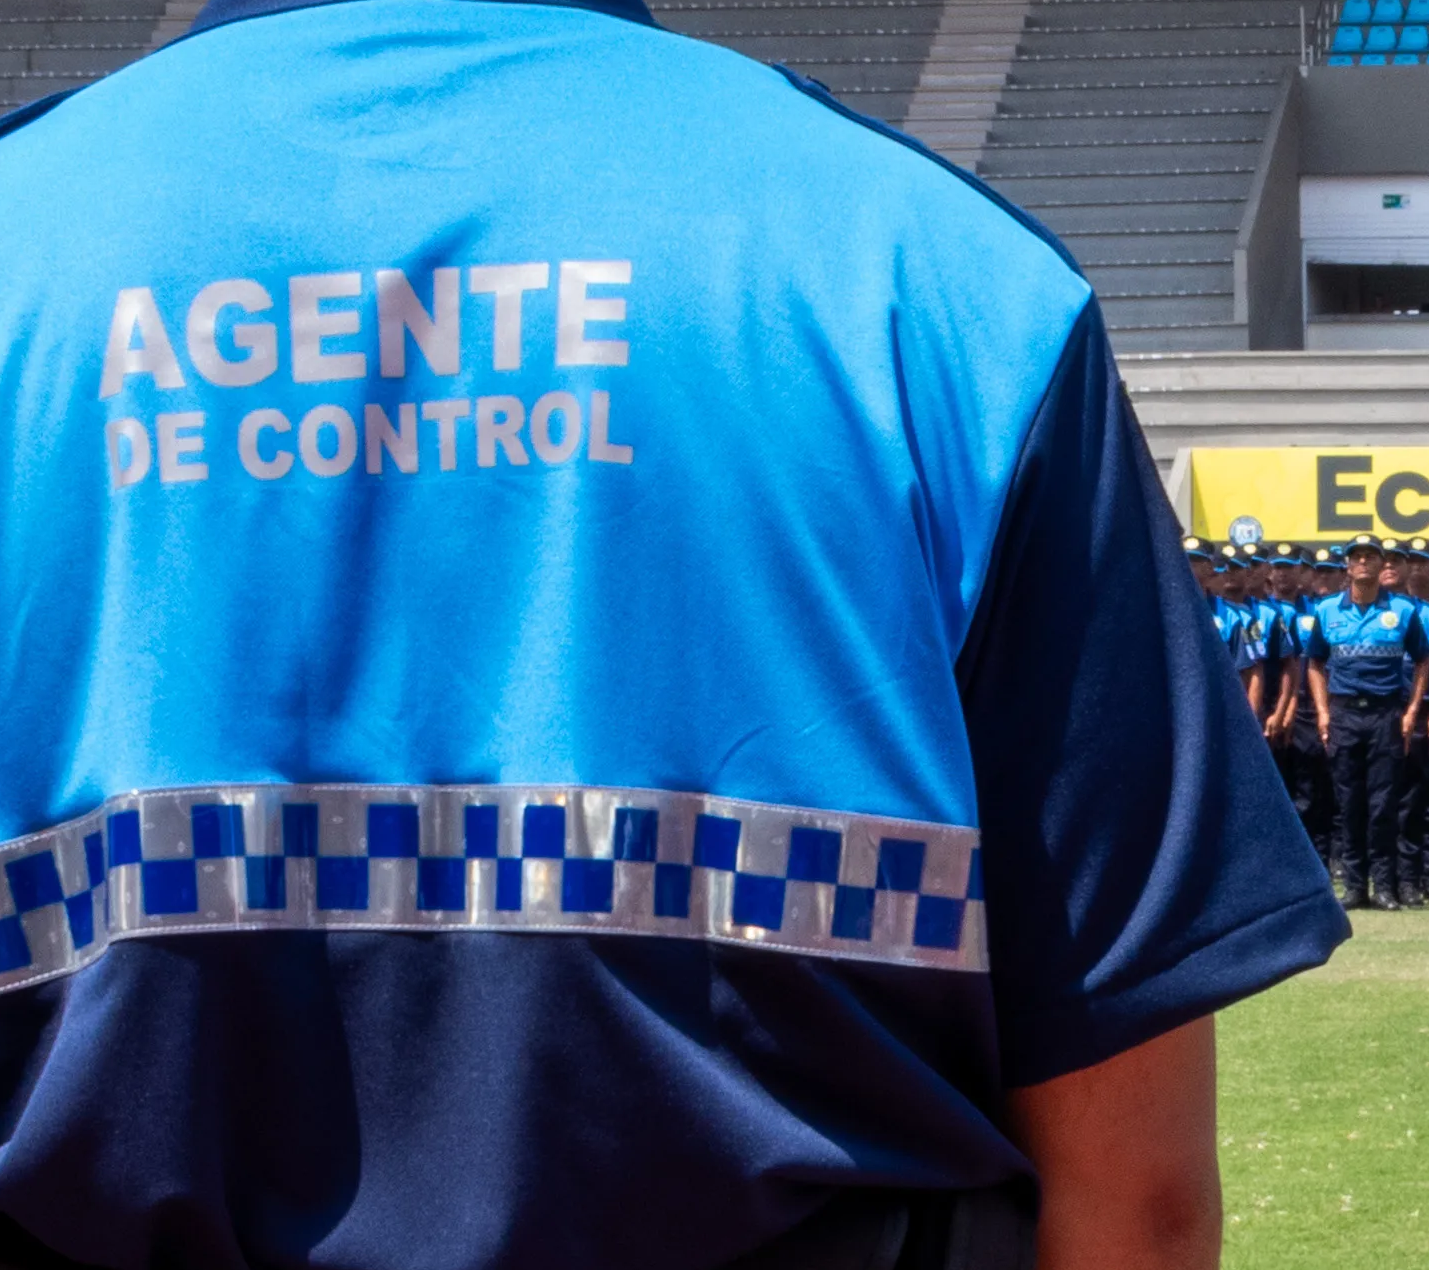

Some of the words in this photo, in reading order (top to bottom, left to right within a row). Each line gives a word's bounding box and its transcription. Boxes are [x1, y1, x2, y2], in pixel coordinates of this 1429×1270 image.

[98, 260, 632, 399] AGENTE
[104, 411, 209, 491] DE
[237, 390, 634, 481] CONTROL
